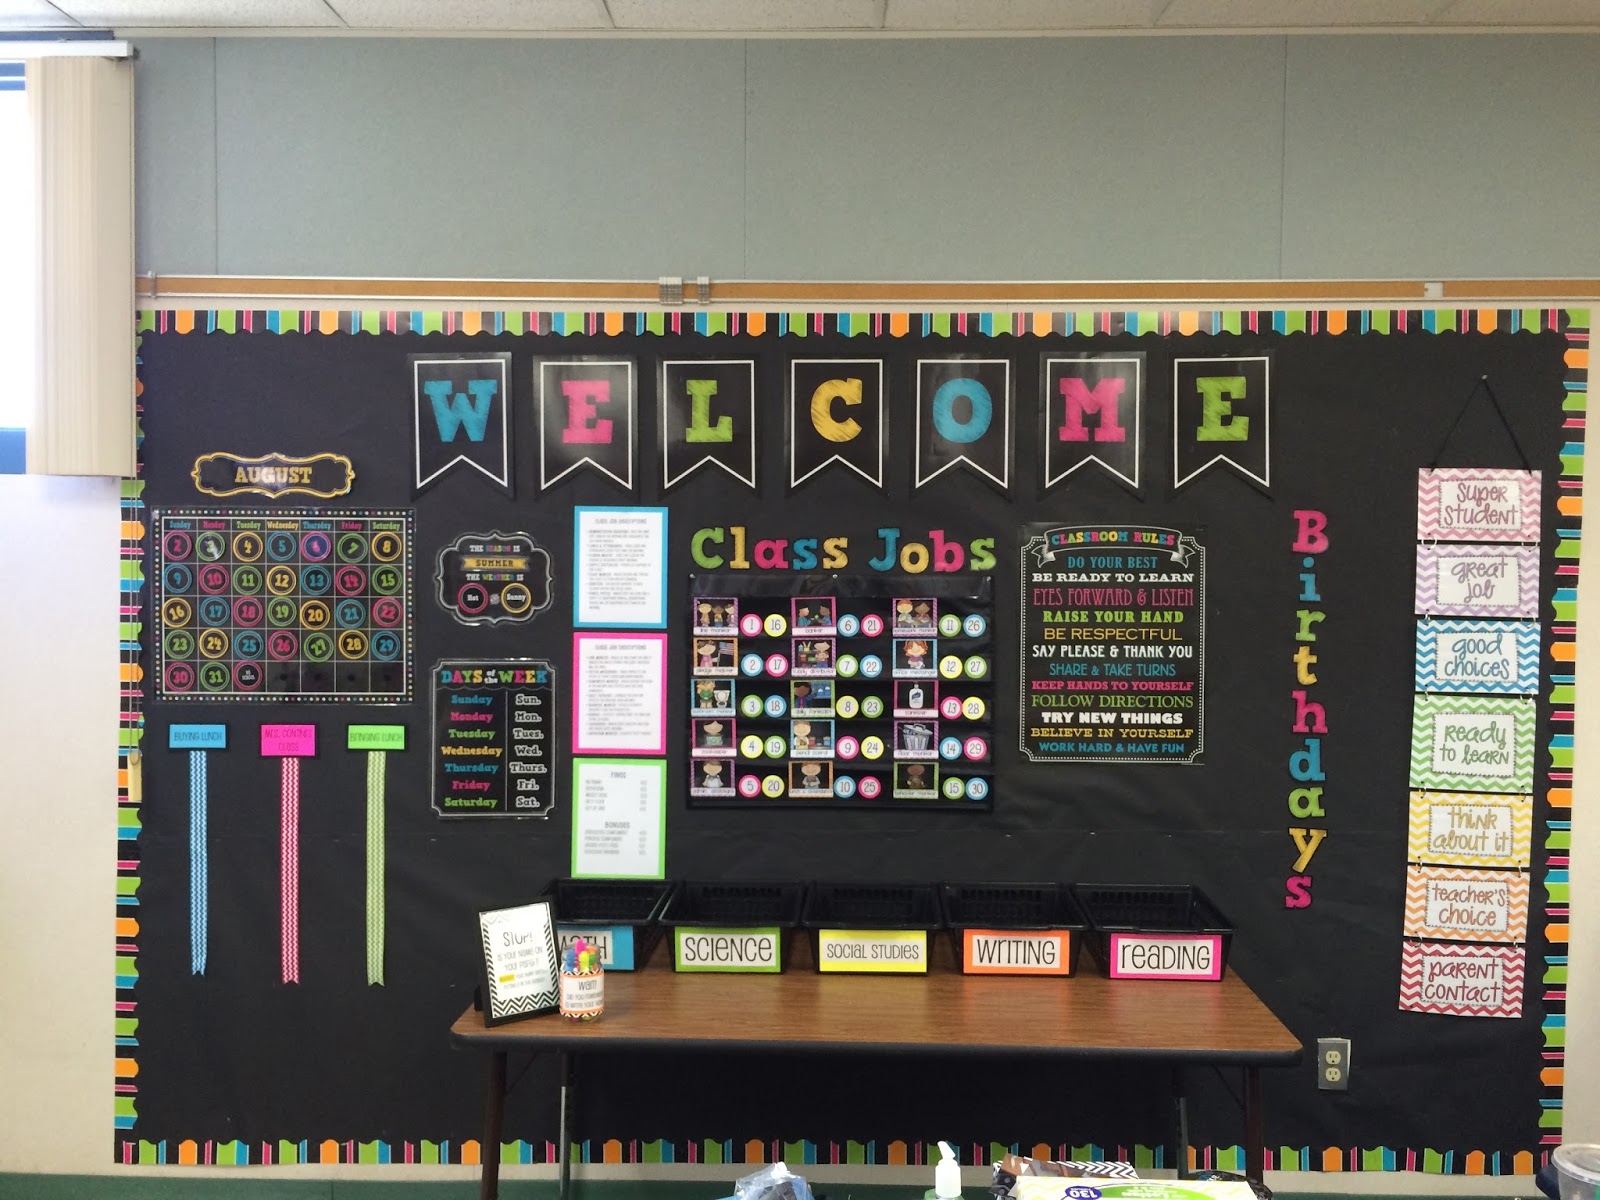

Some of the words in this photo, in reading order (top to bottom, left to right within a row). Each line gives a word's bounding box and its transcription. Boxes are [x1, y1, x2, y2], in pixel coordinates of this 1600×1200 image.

[424, 376, 1249, 443] WELCOME
[235, 466, 313, 483] AUGUST
[1051, 531, 1128, 545] CLASSROOM
[1133, 531, 1175, 546] RULES
[691, 526, 849, 570] Class
[868, 527, 997, 573] Jobs
[476, 559, 514, 567] SUMMER
[1067, 556, 1085, 569] DO
[1090, 556, 1123, 569] YOUR
[1127, 556, 1158, 569] BEST
[241, 574, 254, 587] 11
[275, 573, 290, 588] 12
[309, 574, 324, 587] 13
[380, 573, 396, 587] 15
[1031, 573, 1053, 583] BE
[1056, 573, 1111, 583] READY
[1115, 573, 1135, 583] TO
[1138, 573, 1195, 583] LEARN
[1463, 576, 1495, 602] job
[1033, 588, 1063, 606] EYES
[1067, 588, 1132, 606] FORWARD
[1136, 588, 1147, 606] &
[1151, 588, 1194, 606] LISTEN
[168, 605, 185, 621] 16
[208, 605, 223, 618] 17
[275, 605, 289, 619] 19
[307, 608, 324, 622] 20
[344, 607, 359, 620] 21
[1042, 610, 1088, 623] RAISE
[1094, 610, 1135, 623] YOUR
[1140, 610, 1184, 623] HAND
[749, 619, 755, 630] 1
[771, 619, 781, 631] 16
[844, 620, 852, 631] 6
[867, 620, 877, 631] 21
[946, 619, 954, 631] 11
[968, 620, 980, 631] 26
[1044, 627, 1067, 641] BE
[1071, 628, 1183, 641] RESPECTFUL
[172, 638, 188, 651] 23
[207, 636, 222, 651] 24
[346, 638, 362, 651] 28
[1452, 633, 1503, 659] good
[1032, 645, 1056, 658] SAY
[1060, 645, 1105, 658] PLEASE
[1109, 645, 1119, 658] &
[1123, 645, 1164, 658] THANK
[1168, 645, 1193, 658] YOU
[750, 660, 756, 671] 2
[774, 659, 783, 670] 17
[844, 660, 850, 672] 7
[866, 661, 877, 672] 22
[946, 661, 956, 672] 12
[970, 661, 981, 672] 27
[1049, 663, 1088, 676] SHARE
[1091, 666, 1099, 676] &
[1103, 664, 1132, 676] TAKE
[1136, 664, 1176, 677] TURNS
[441, 670, 483, 684] DAYS
[486, 669, 496, 677] of
[498, 670, 548, 684] WEEK
[484, 676, 498, 684] the
[1031, 681, 1065, 690] KEEP
[1067, 681, 1108, 690] HANDS
[1111, 681, 1128, 690] TO
[1131, 681, 1194, 691] YOURSELF
[451, 694, 493, 706] Sunday
[515, 693, 542, 706] Sun.
[1031, 694, 1095, 708] FOLLOW
[1099, 694, 1194, 708] DIRECTIONS
[750, 701, 755, 712] 3
[770, 700, 781, 712] 18
[844, 701, 851, 713] 8
[867, 701, 878, 713] 23
[967, 703, 980, 714] 28
[450, 712, 493, 724] Monday
[515, 711, 542, 723] Mon.
[1041, 712, 1075, 724] TRY
[1078, 712, 1117, 724] NEW
[1120, 712, 1184, 725] THINGS
[448, 729, 496, 740] Tuesday
[513, 728, 544, 739] Tues.
[1030, 727, 1093, 737] BELIEVE
[1097, 728, 1115, 738] IN
[1119, 728, 1194, 739] YOURSELF
[441, 746, 503, 757] Wednesday
[514, 745, 542, 756] Wed.
[771, 741, 781, 753] 19
[844, 742, 852, 754] 9
[866, 742, 879, 754] 24
[969, 743, 982, 755] 29
[1038, 742, 1075, 752] WORK
[1078, 742, 1113, 752] HARD
[1127, 743, 1159, 753] HAVE
[1161, 743, 1185, 753] FUN
[1439, 743, 1457, 762] to
[444, 763, 499, 775] Thursday
[509, 762, 548, 774] Thurs.
[452, 780, 491, 792] Friday
[517, 779, 540, 790] Fri.
[747, 780, 754, 791] 5
[768, 780, 780, 792] 20
[840, 781, 850, 793] 10
[864, 782, 876, 793] 25
[949, 783, 959, 794] 15
[971, 783, 983, 795] 30
[444, 797, 498, 808] Saturday
[516, 796, 540, 808] Sat.
[1433, 829, 1489, 851] about
[1494, 831, 1509, 852] it
[1438, 903, 1497, 926] choice
